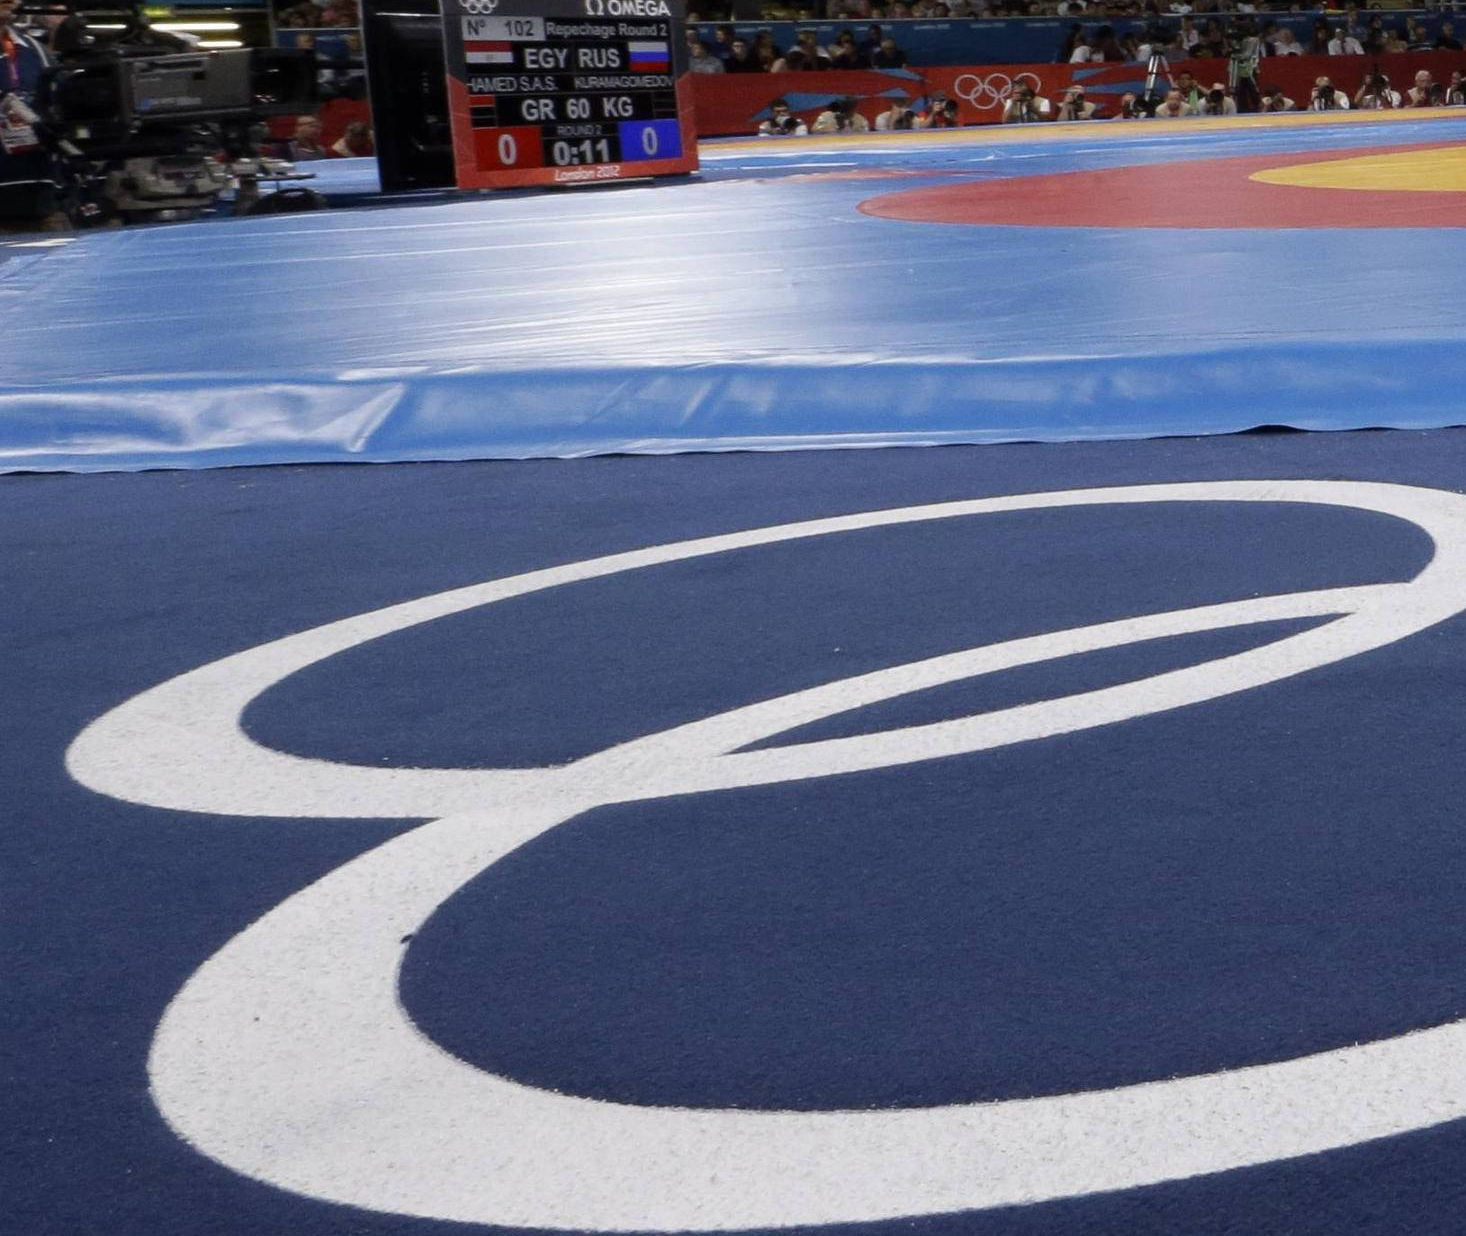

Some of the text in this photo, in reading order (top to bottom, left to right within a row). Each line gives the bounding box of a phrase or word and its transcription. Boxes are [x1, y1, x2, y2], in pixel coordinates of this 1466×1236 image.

[608, 0, 671, 16] OMEGA
[504, 20, 534, 37] 102
[546, 20, 668, 39] Repechage Round 2
[524, 48, 621, 69] EGY RUS
[519, 76, 558, 92] S.A.S.
[574, 75, 674, 91] KURAMAGOMEDOV
[521, 96, 634, 121] GR 60 KG
[557, 125, 602, 136] ROUND 2
[498, 133, 518, 164] 0
[641, 126, 659, 156] 0
[553, 138, 611, 166] 0:11
[554, 164, 620, 181] London 2012
